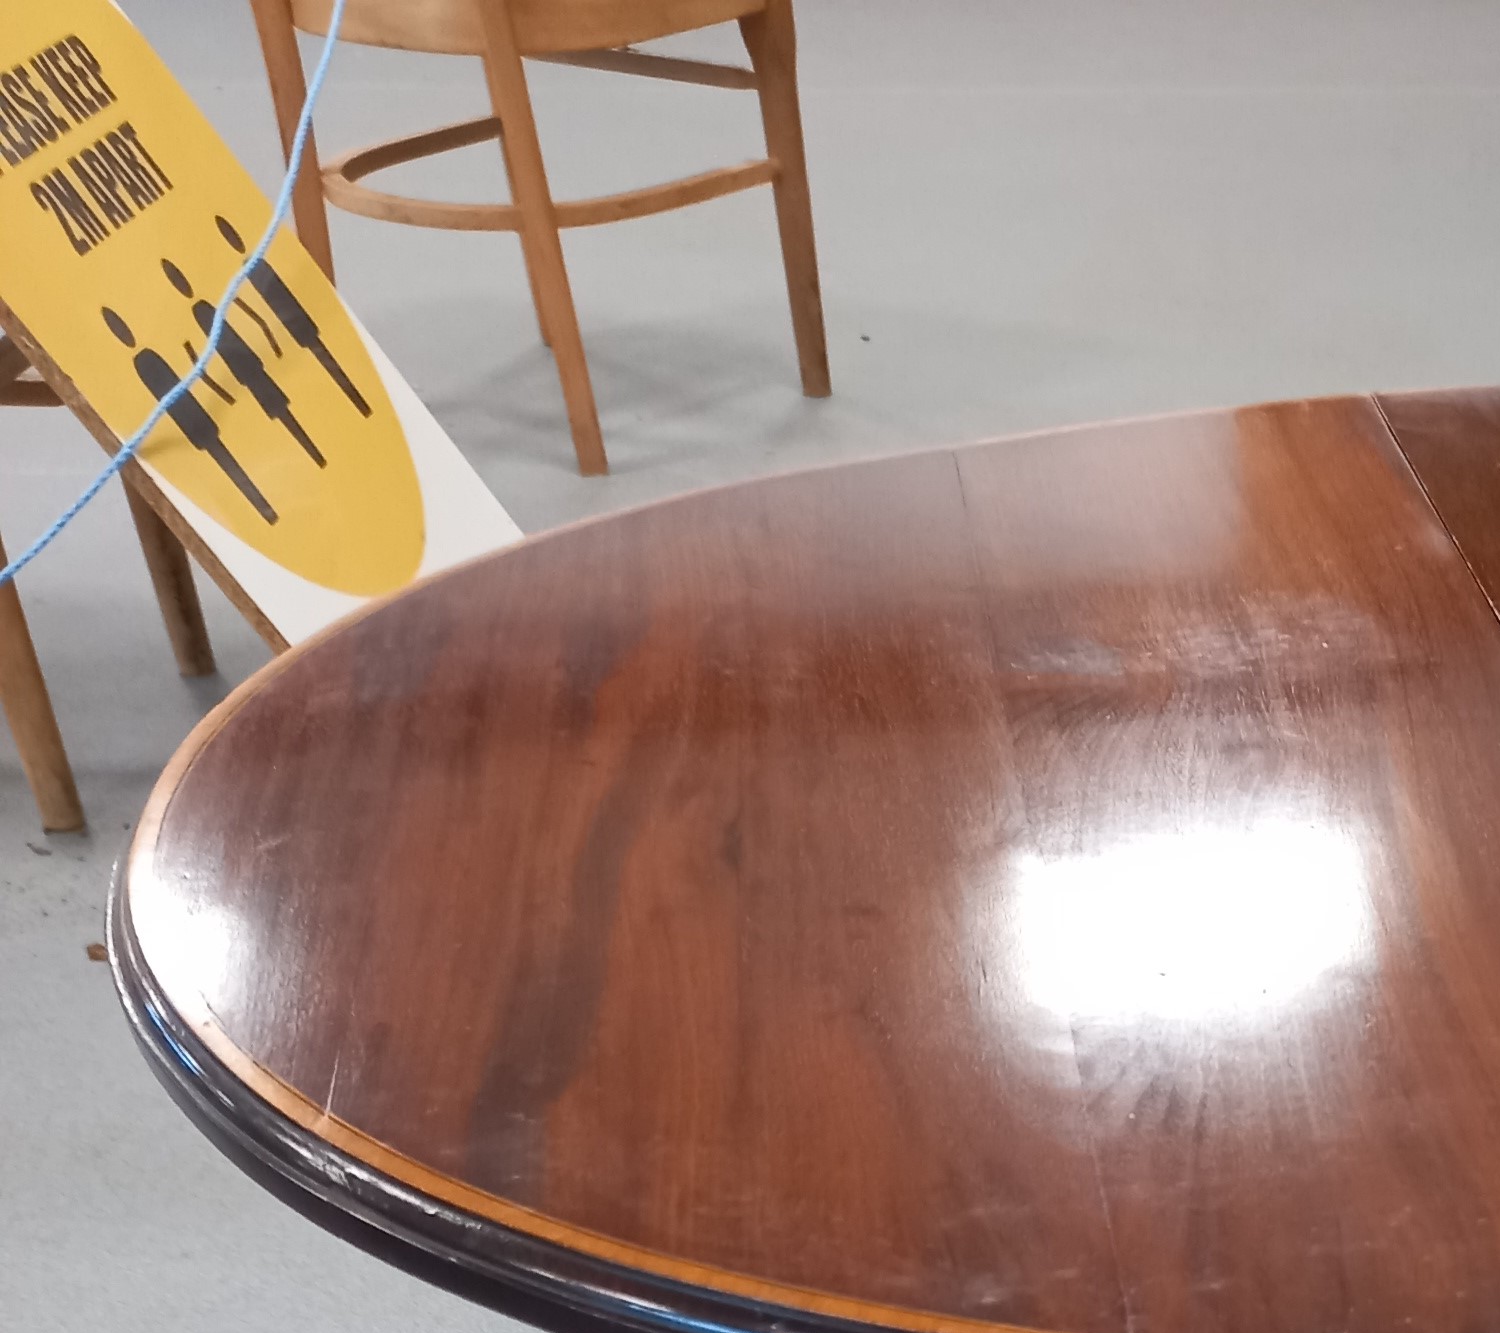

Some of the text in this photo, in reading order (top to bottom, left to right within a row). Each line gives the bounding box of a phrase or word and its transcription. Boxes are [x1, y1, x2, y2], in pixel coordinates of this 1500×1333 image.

[28, 33, 118, 124] KEEP
[29, 120, 174, 257] 2M APART
